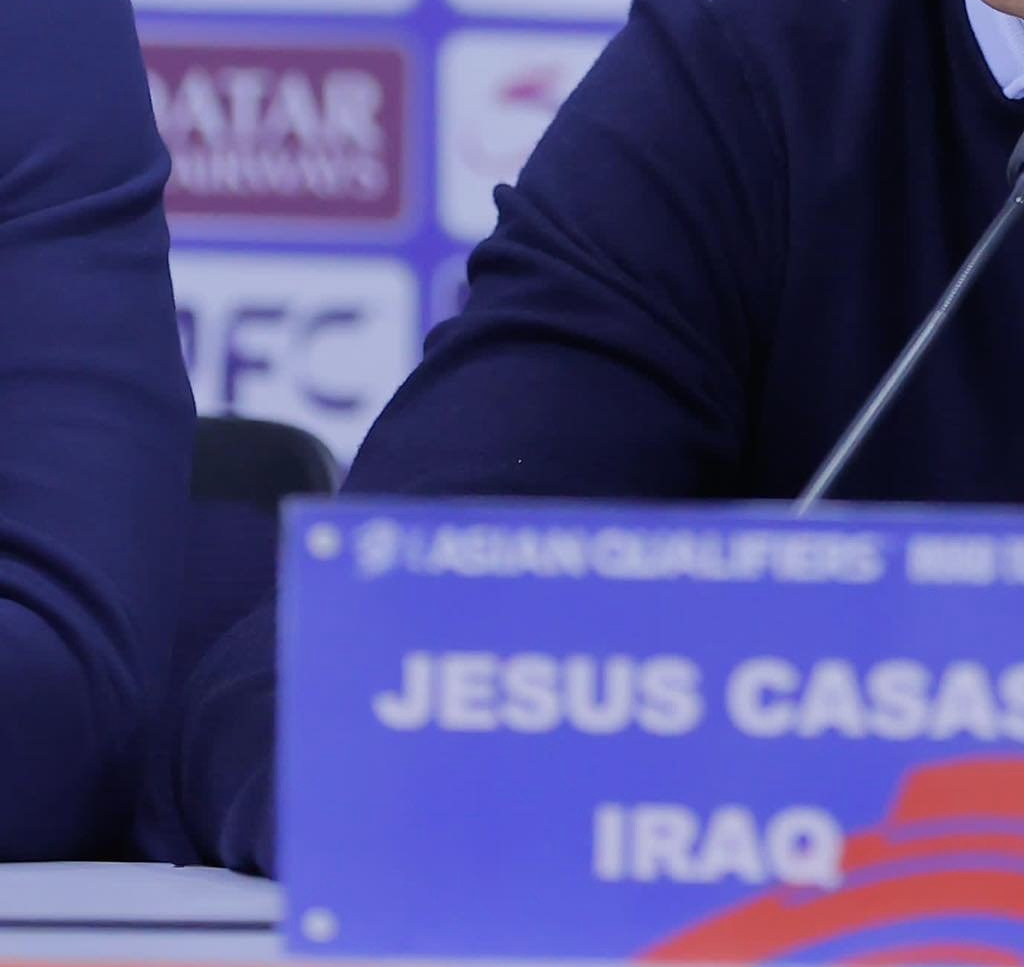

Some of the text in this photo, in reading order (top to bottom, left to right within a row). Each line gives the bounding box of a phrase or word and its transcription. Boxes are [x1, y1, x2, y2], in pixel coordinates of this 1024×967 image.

[150, 68, 384, 152] ATAR
[431, 525, 588, 579] ASIAN
[594, 529, 886, 584] QUALIFIERS
[372, 652, 705, 736] JESUS
[592, 803, 845, 891] IRAQ
